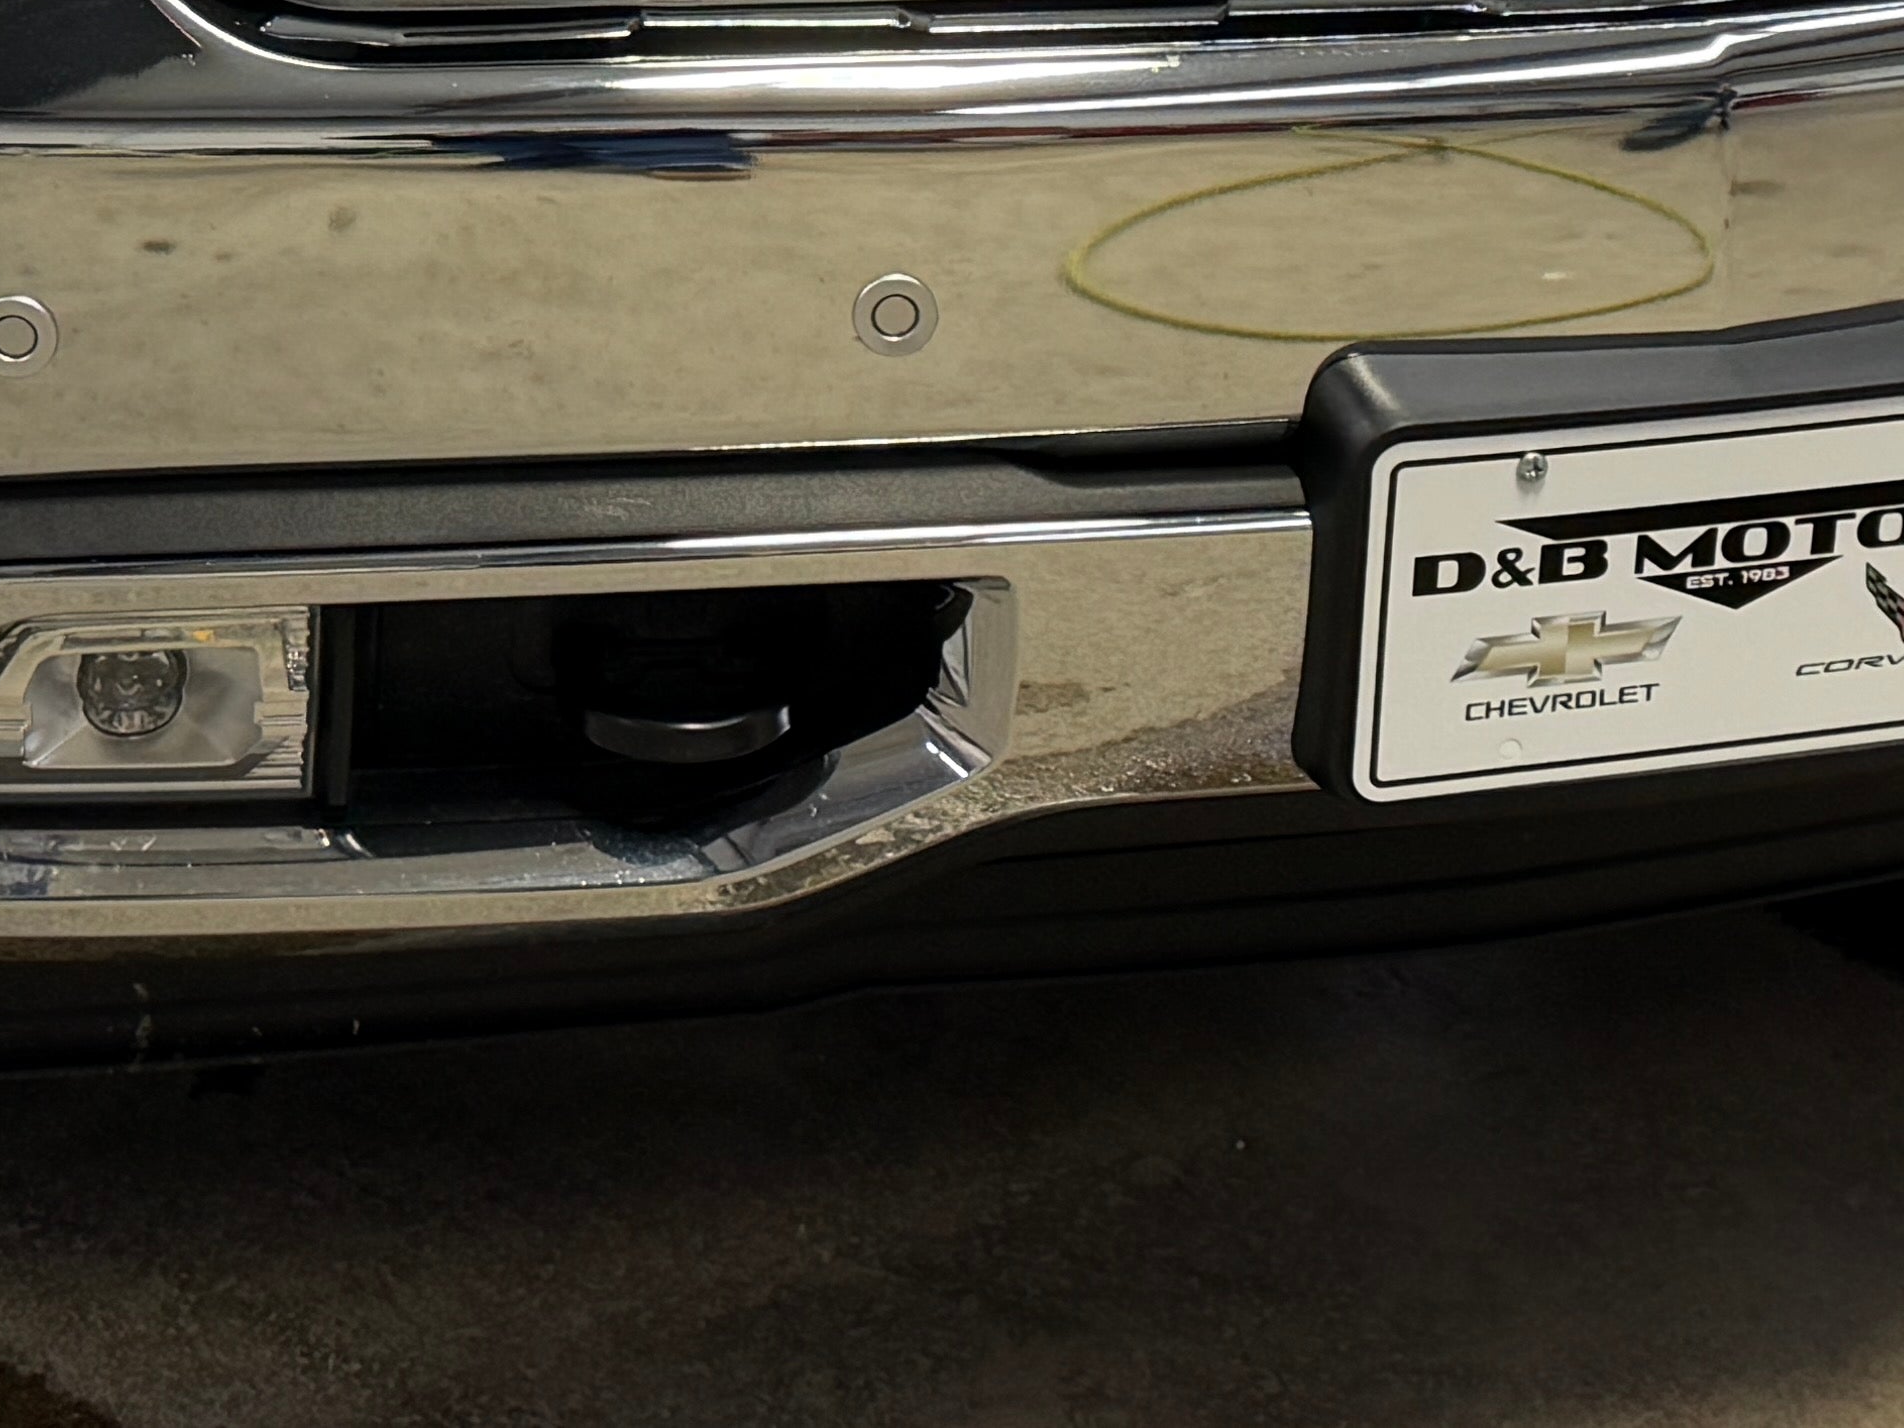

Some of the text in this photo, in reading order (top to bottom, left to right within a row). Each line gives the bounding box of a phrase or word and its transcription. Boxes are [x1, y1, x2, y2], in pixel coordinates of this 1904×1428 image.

[1411, 538, 1609, 598] D&B
[1685, 565, 1791, 590] EST. 1983
[1464, 682, 1661, 722] CHEVROLET
